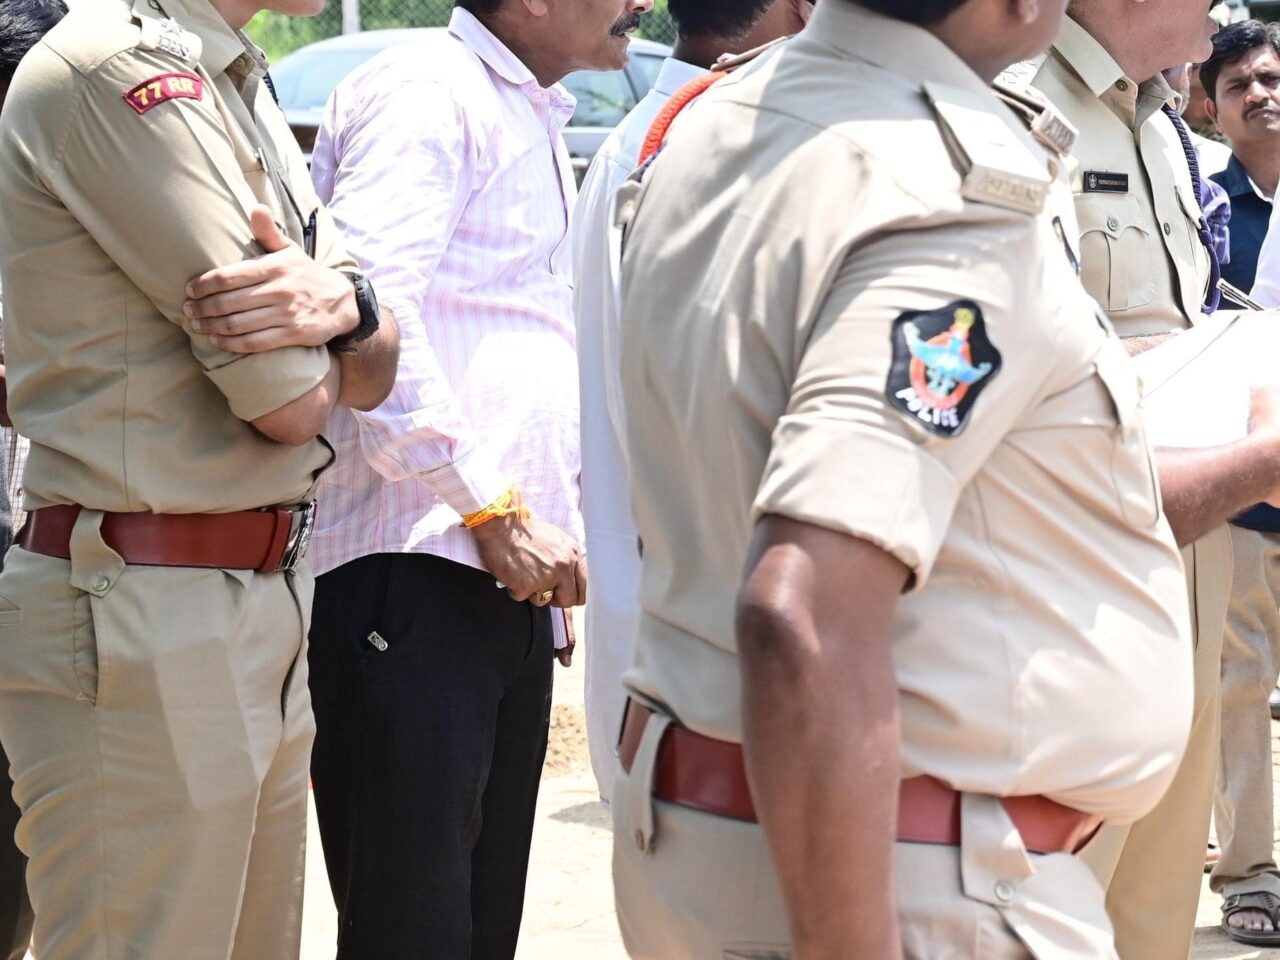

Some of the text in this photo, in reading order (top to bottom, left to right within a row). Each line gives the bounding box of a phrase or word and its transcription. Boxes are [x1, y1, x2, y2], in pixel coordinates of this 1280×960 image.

[133, 77, 195, 106] 77 RR
[895, 387, 959, 427] POLICE
